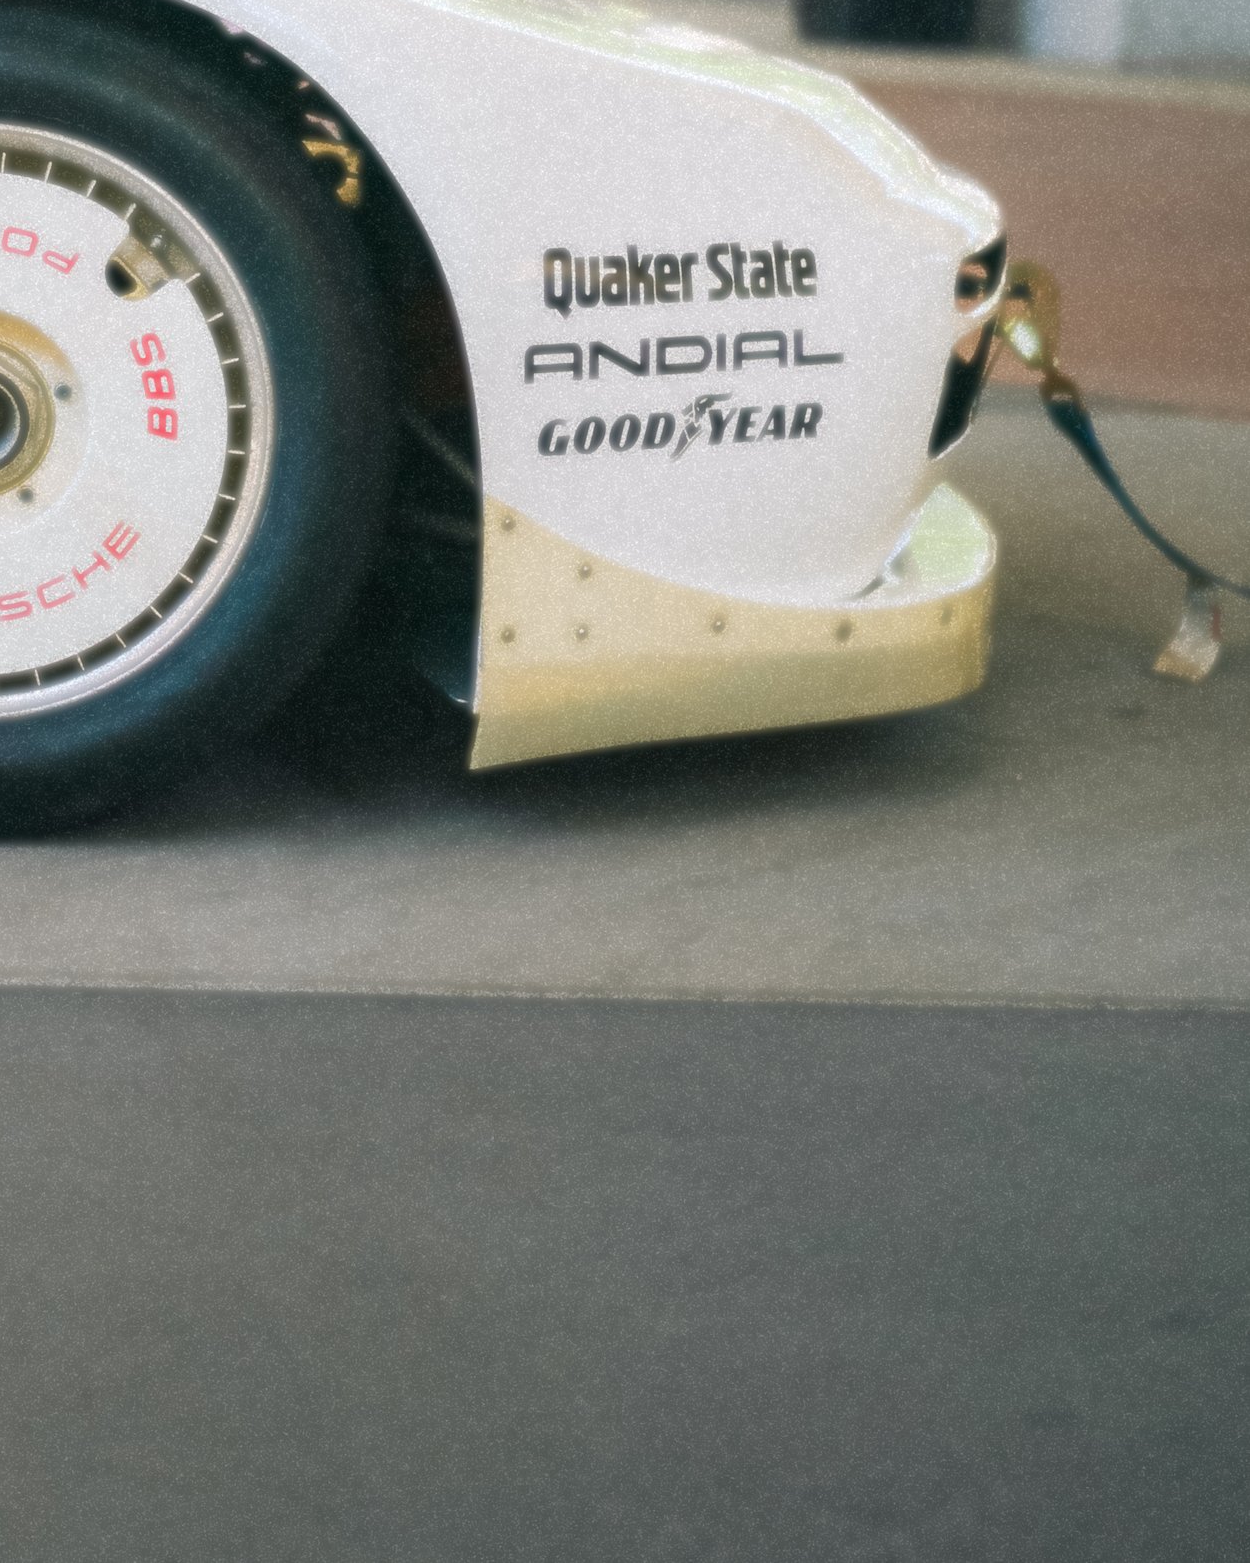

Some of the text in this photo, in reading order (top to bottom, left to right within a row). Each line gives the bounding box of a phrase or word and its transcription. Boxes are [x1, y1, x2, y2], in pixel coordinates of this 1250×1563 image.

[542, 240, 818, 319] Quaker State
[129, 331, 180, 442] BBS
[523, 329, 845, 384] ANDIAL
